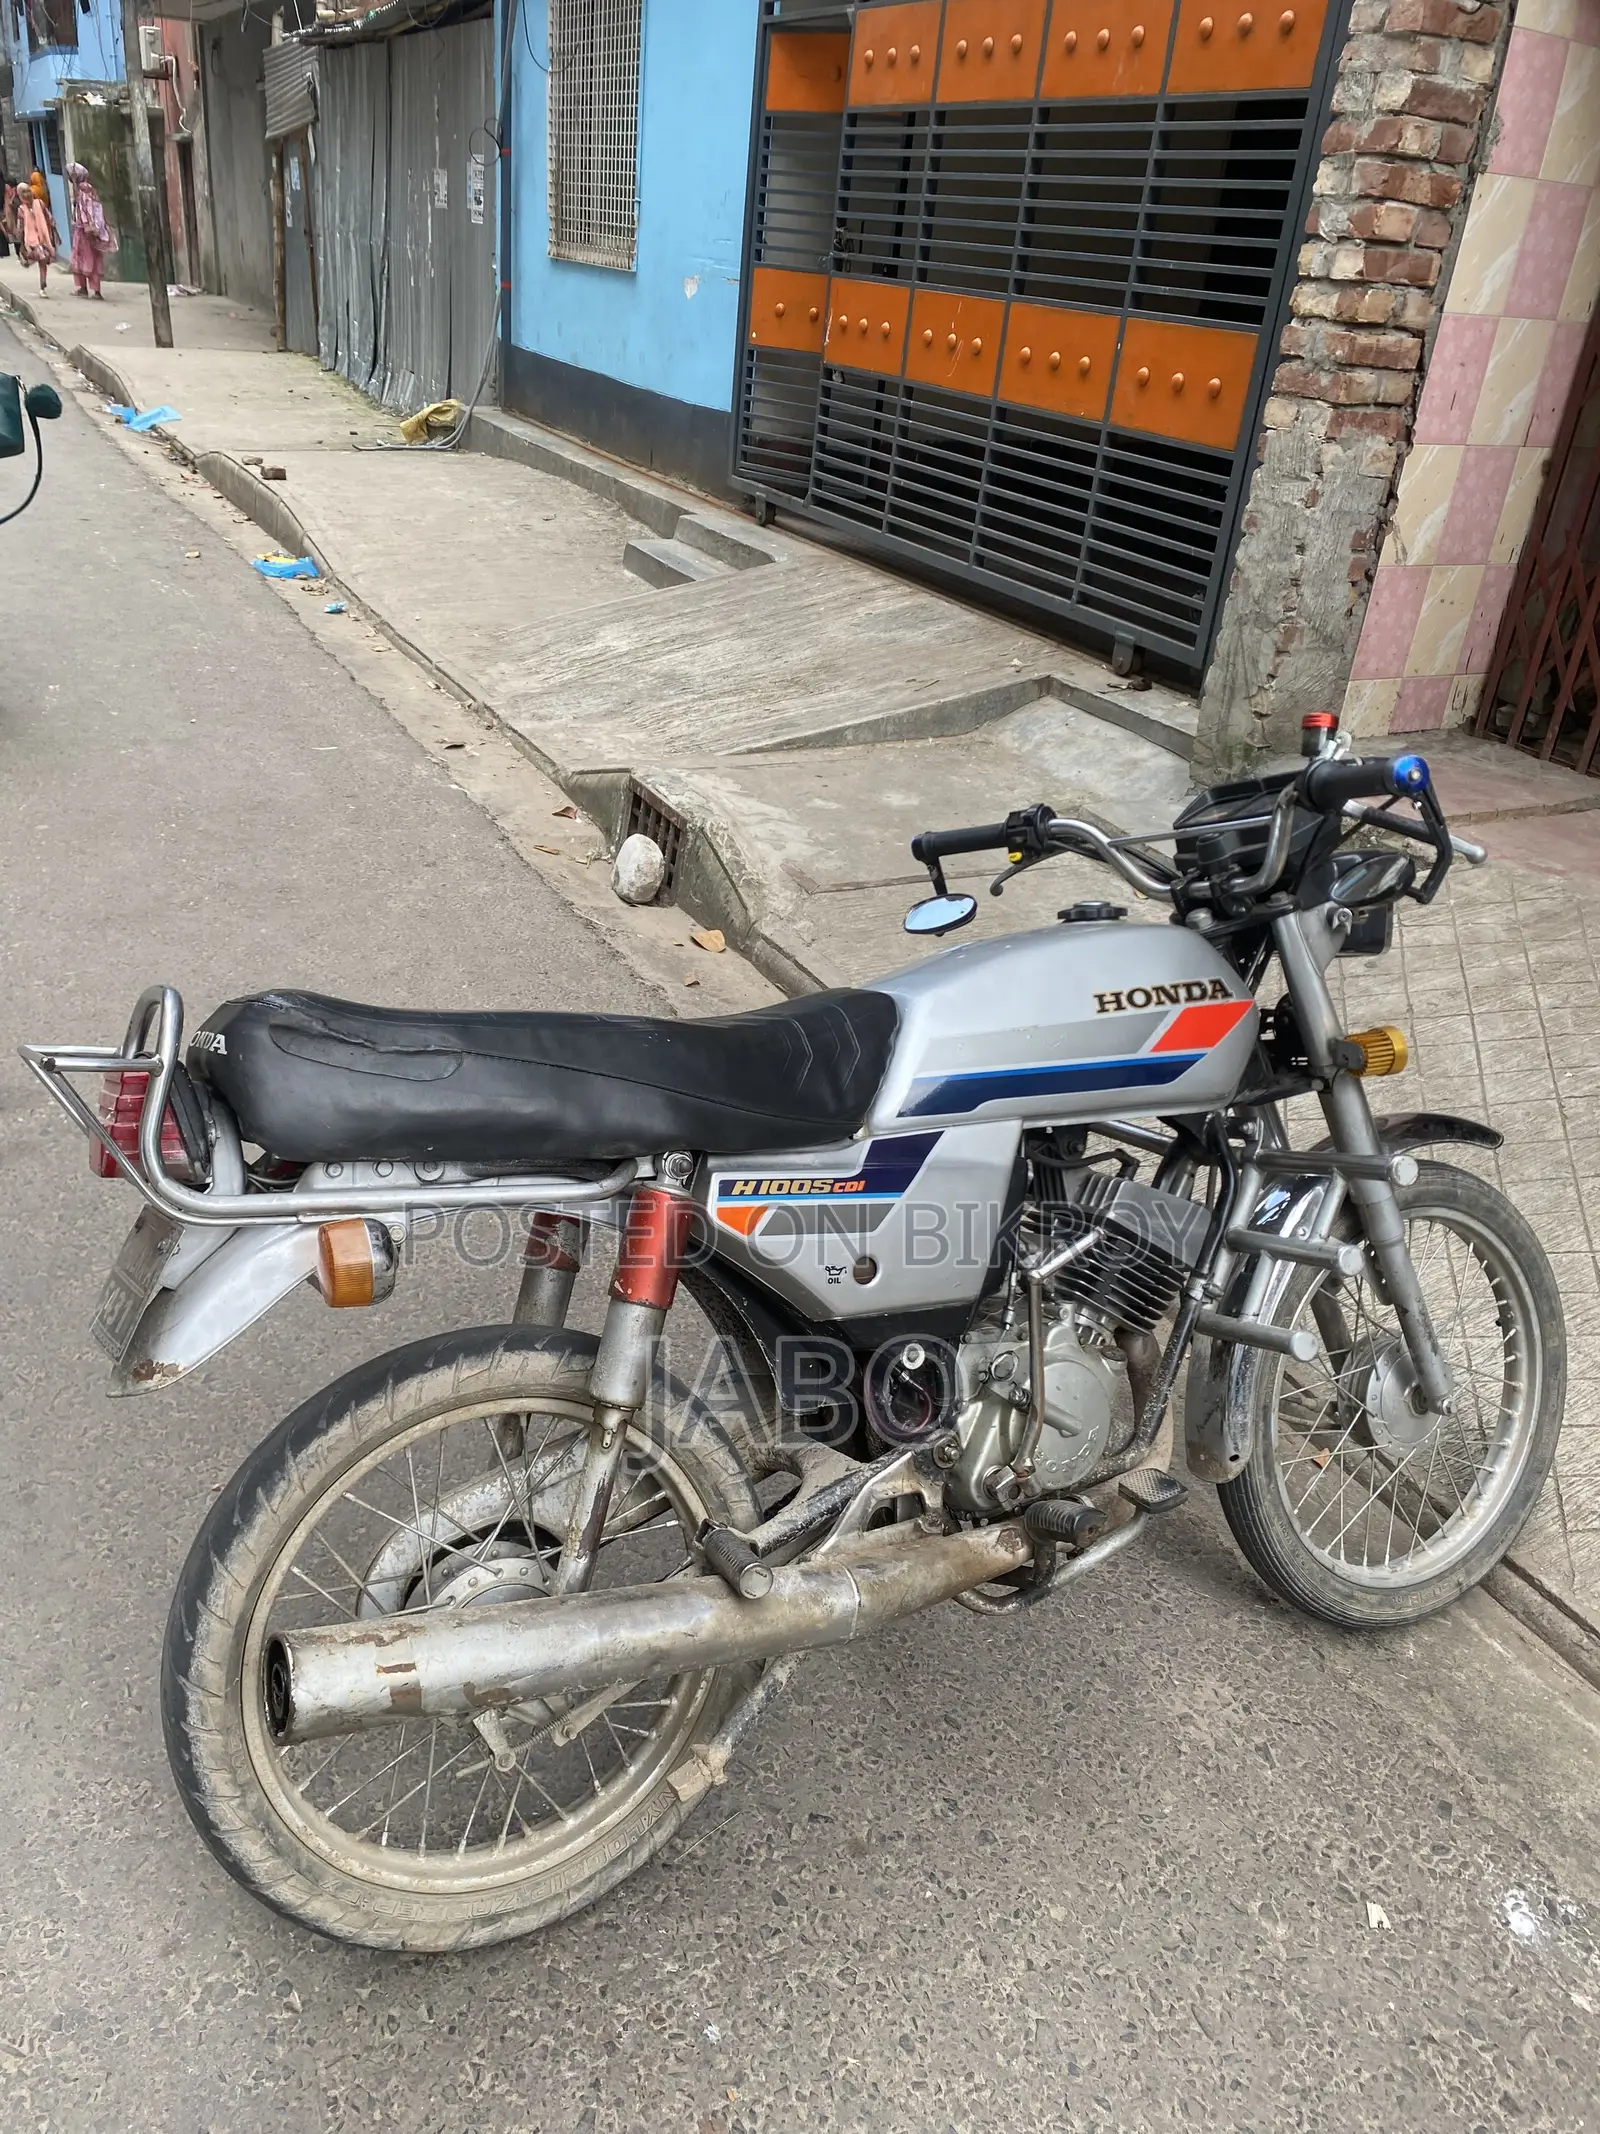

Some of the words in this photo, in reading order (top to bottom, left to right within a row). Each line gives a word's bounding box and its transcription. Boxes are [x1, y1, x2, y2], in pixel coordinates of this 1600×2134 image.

[1093, 978, 1234, 1013] HONDA
[190, 1031, 228, 1055] ONDA
[833, 1180, 866, 1193] CDI
[827, 1277, 842, 1285] OIL
